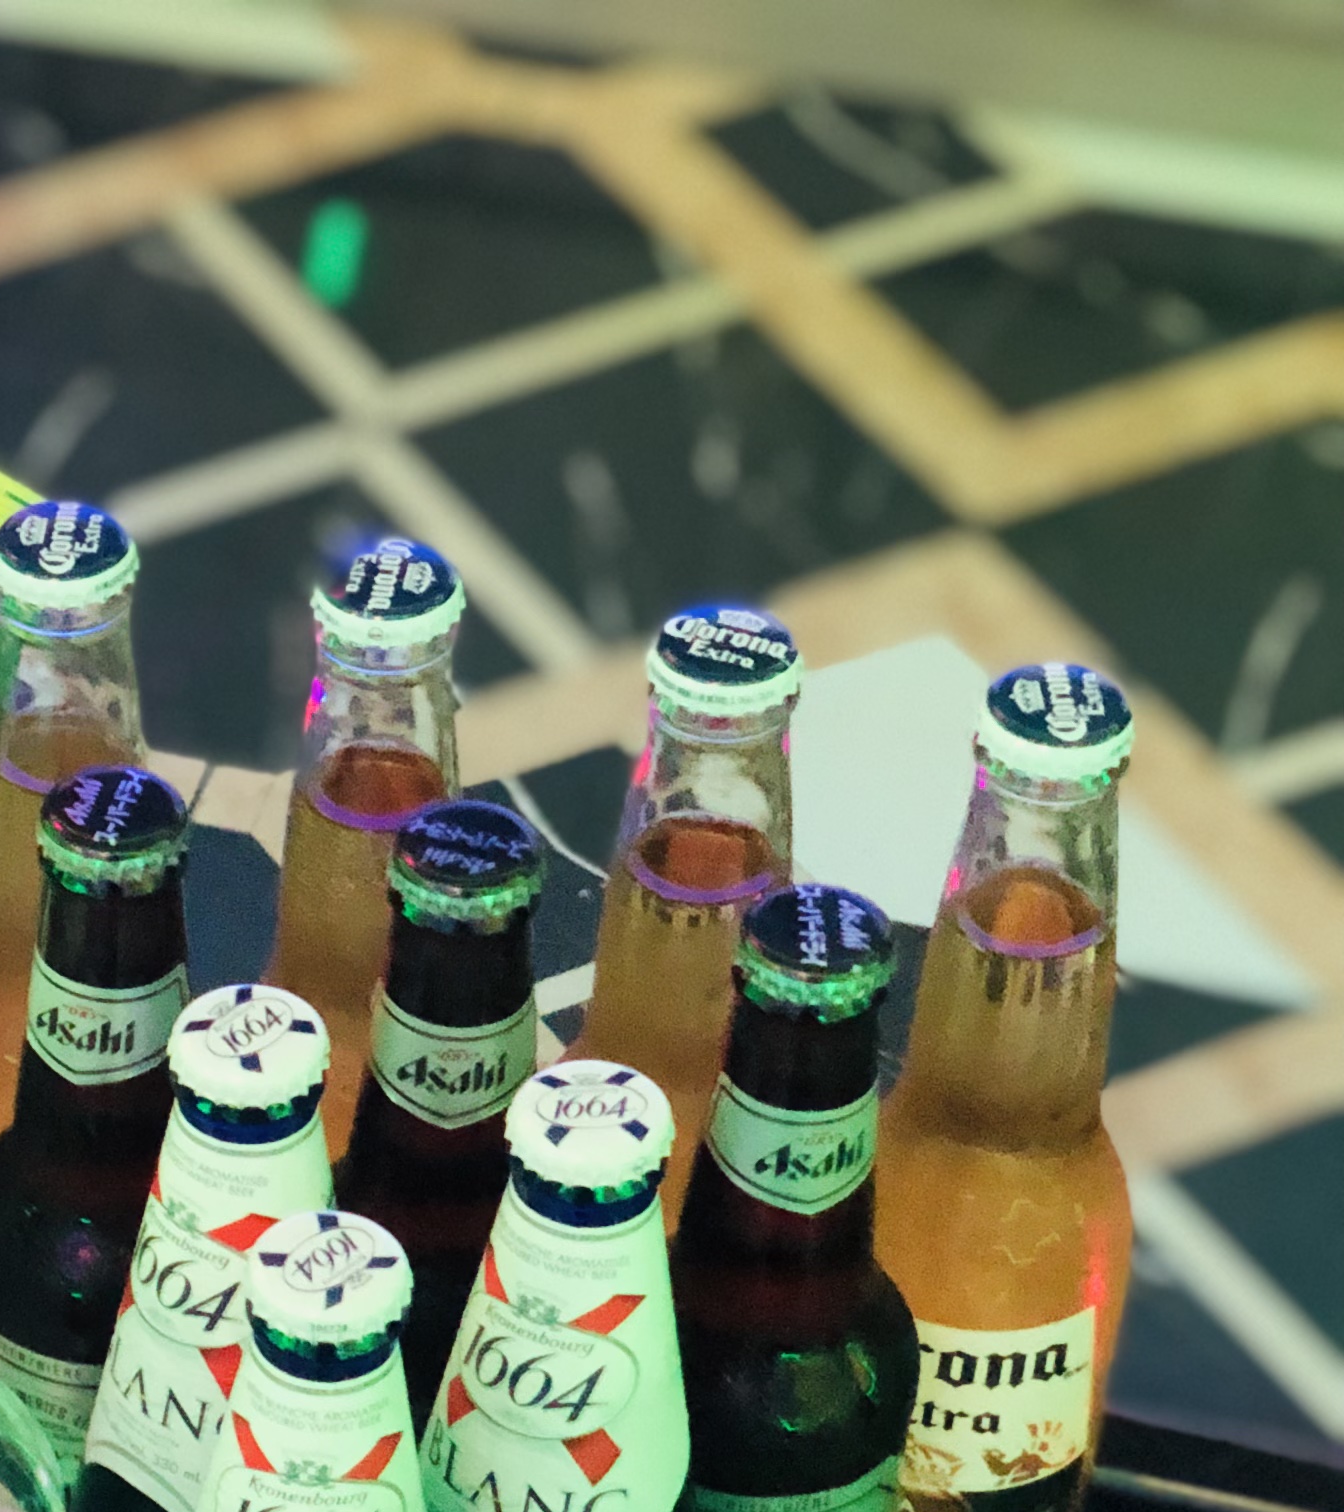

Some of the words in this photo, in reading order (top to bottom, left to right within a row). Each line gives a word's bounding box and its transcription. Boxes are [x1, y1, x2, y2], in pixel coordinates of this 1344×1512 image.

[664, 615, 790, 659] Corona
[688, 639, 755, 670] Extra
[1042, 663, 1090, 742] Corona
[35, 1006, 136, 1055] Asahi
[221, 1004, 284, 1054] 1664
[396, 1050, 508, 1095] Asahi
[554, 1096, 638, 1120] 1664
[753, 1128, 865, 1182] Asahi
[292, 1230, 359, 1283] 1664
[484, 1303, 595, 1358] Kronenbourg
[464, 1324, 609, 1423] 1664
[918, 1342, 1069, 1391] ona
[909, 1400, 1001, 1435] tra
[248, 1474, 368, 1507] Kronenbourg
